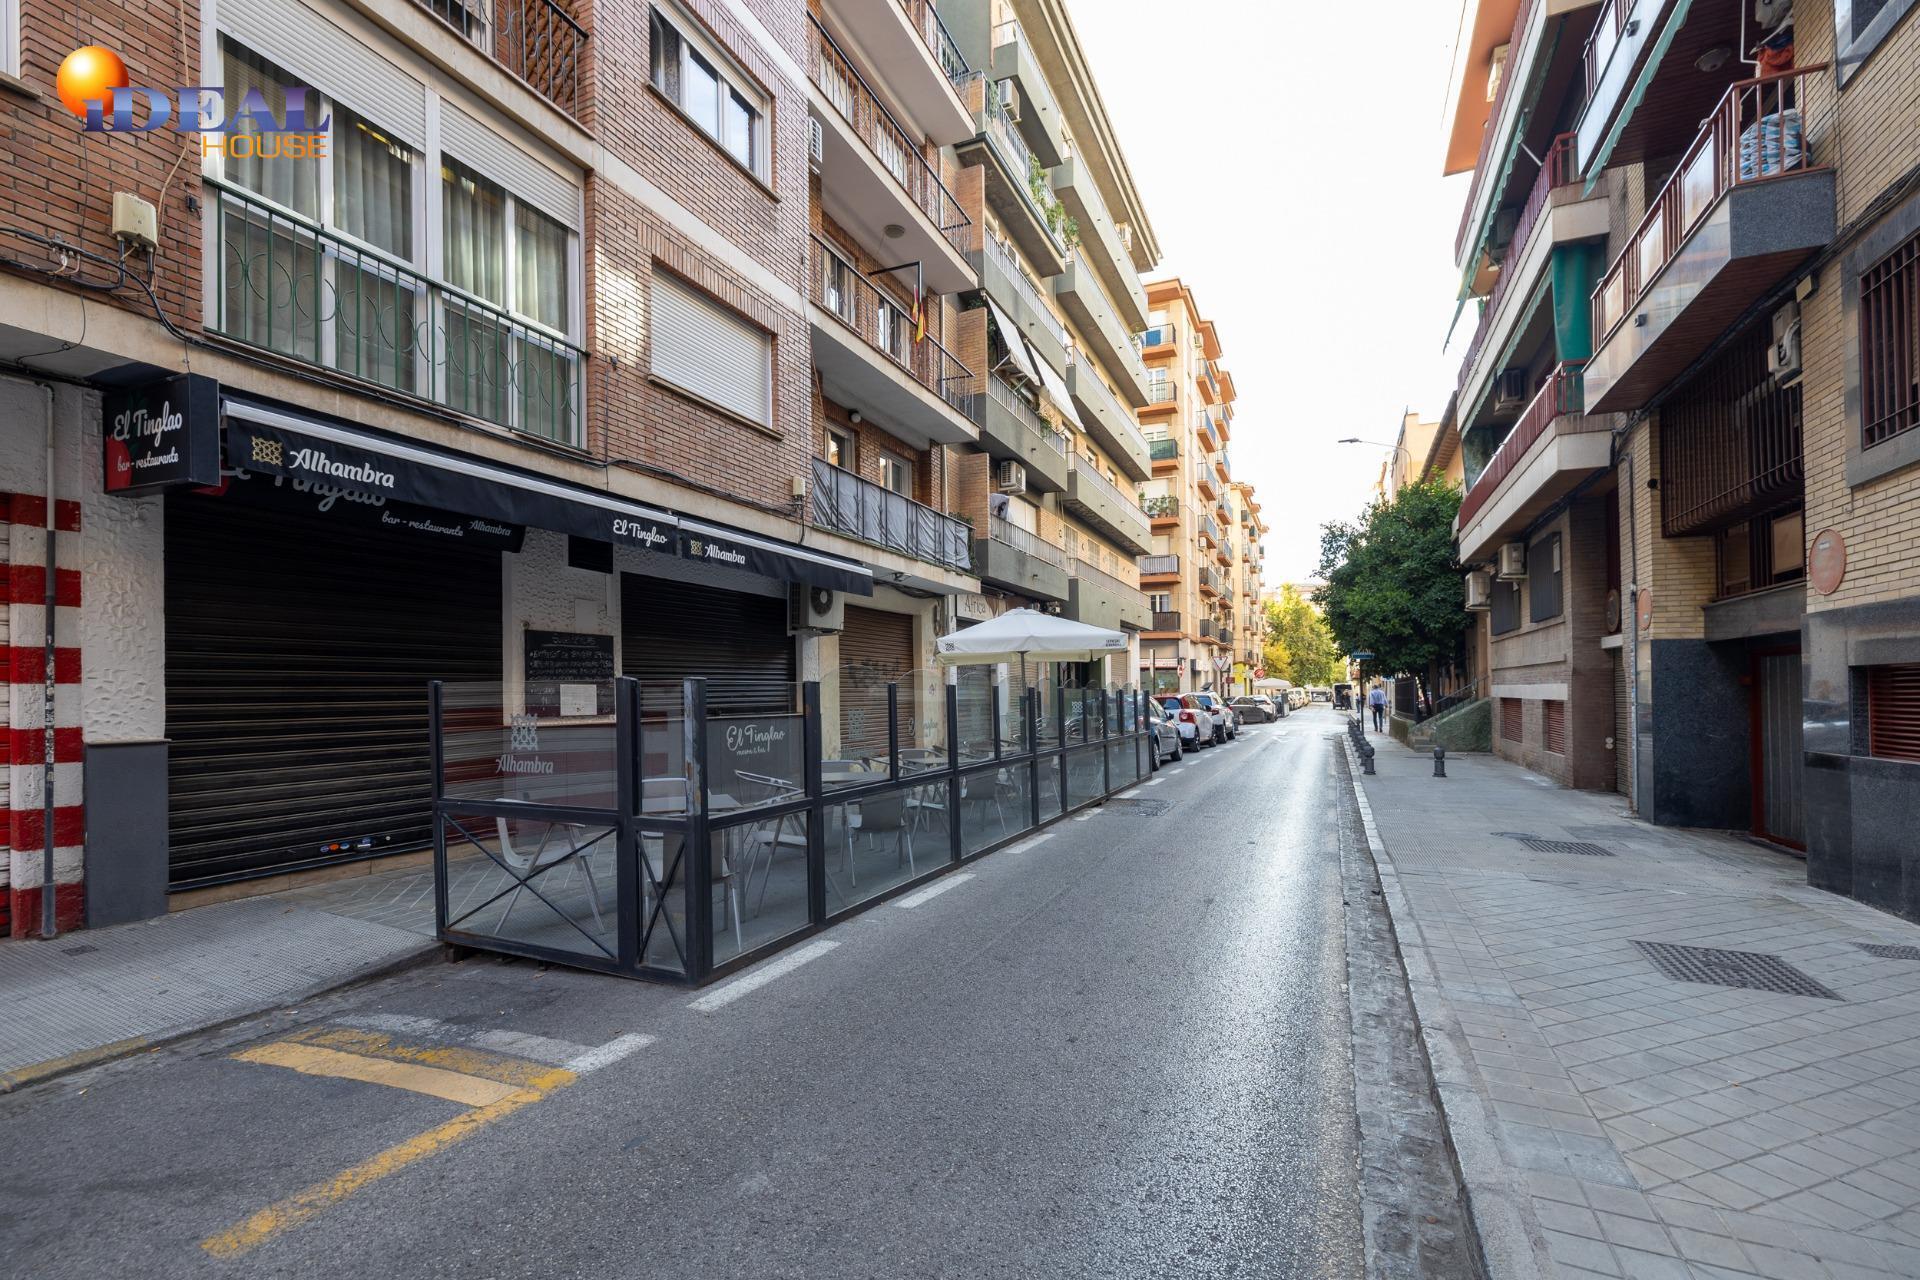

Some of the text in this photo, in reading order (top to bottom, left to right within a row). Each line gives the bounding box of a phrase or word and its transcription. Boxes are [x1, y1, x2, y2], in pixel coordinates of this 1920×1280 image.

[113, 400, 183, 448] El Tinglao
[117, 455, 130, 472] bar
[135, 446, 179, 469] restaurante
[288, 448, 395, 489] Alhambra
[382, 510, 400, 524] bar
[408, 519, 464, 537] restaurante
[468, 520, 512, 537] Alhambra
[612, 519, 668, 548] El Tinglao
[704, 543, 746, 565] Alhambra
[726, 724, 786, 753] El Tinglao
[495, 754, 554, 775] Alhambra
